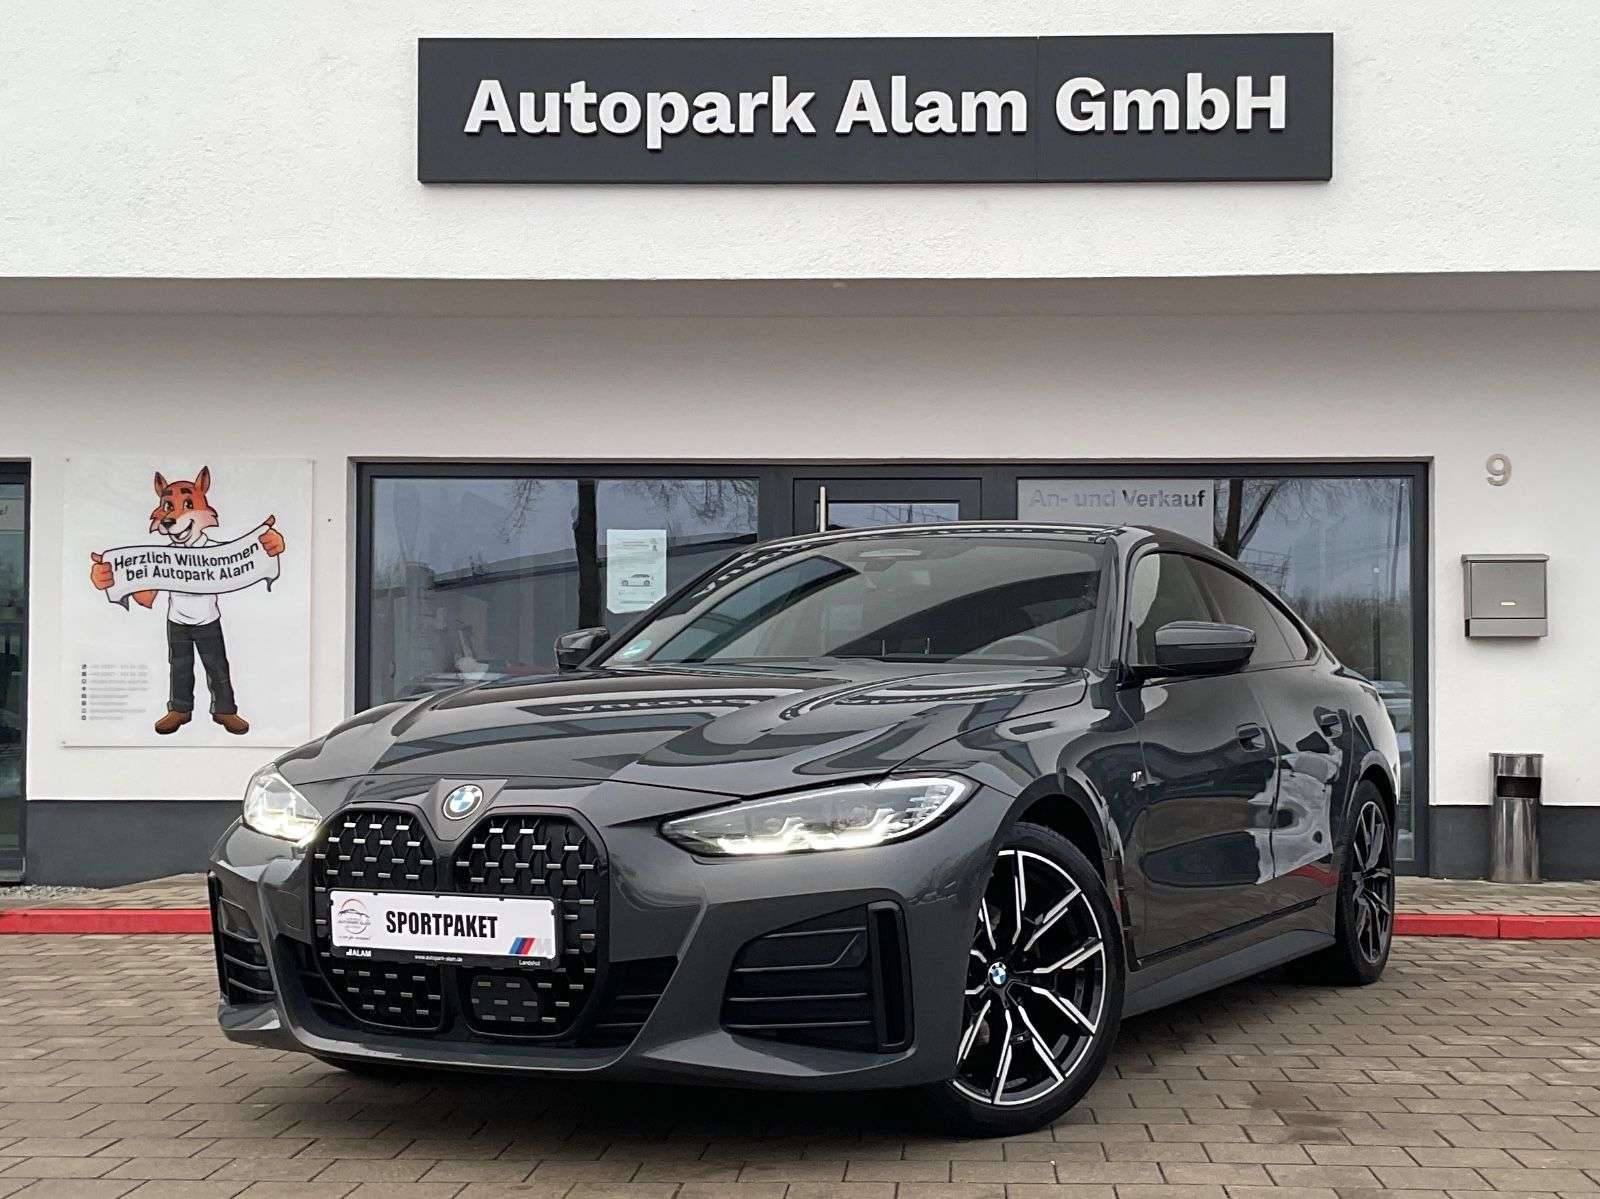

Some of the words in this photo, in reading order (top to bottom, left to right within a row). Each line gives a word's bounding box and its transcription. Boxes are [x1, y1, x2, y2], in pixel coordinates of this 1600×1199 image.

[463, 76, 817, 150] Autopark
[834, 75, 1029, 134] Alam
[1055, 72, 1288, 132] GmbH
[1485, 453, 1512, 487] 9
[1029, 489, 1068, 507] An-
[1074, 489, 1116, 507] und
[1121, 489, 1206, 508] Verkauf
[114, 552, 171, 571] Herzlich
[174, 542, 259, 567] Willkommen
[126, 564, 148, 581] bei
[152, 566, 214, 582] Autopark
[219, 560, 255, 581] Alam
[386, 910, 498, 939] SPORTPAKET
